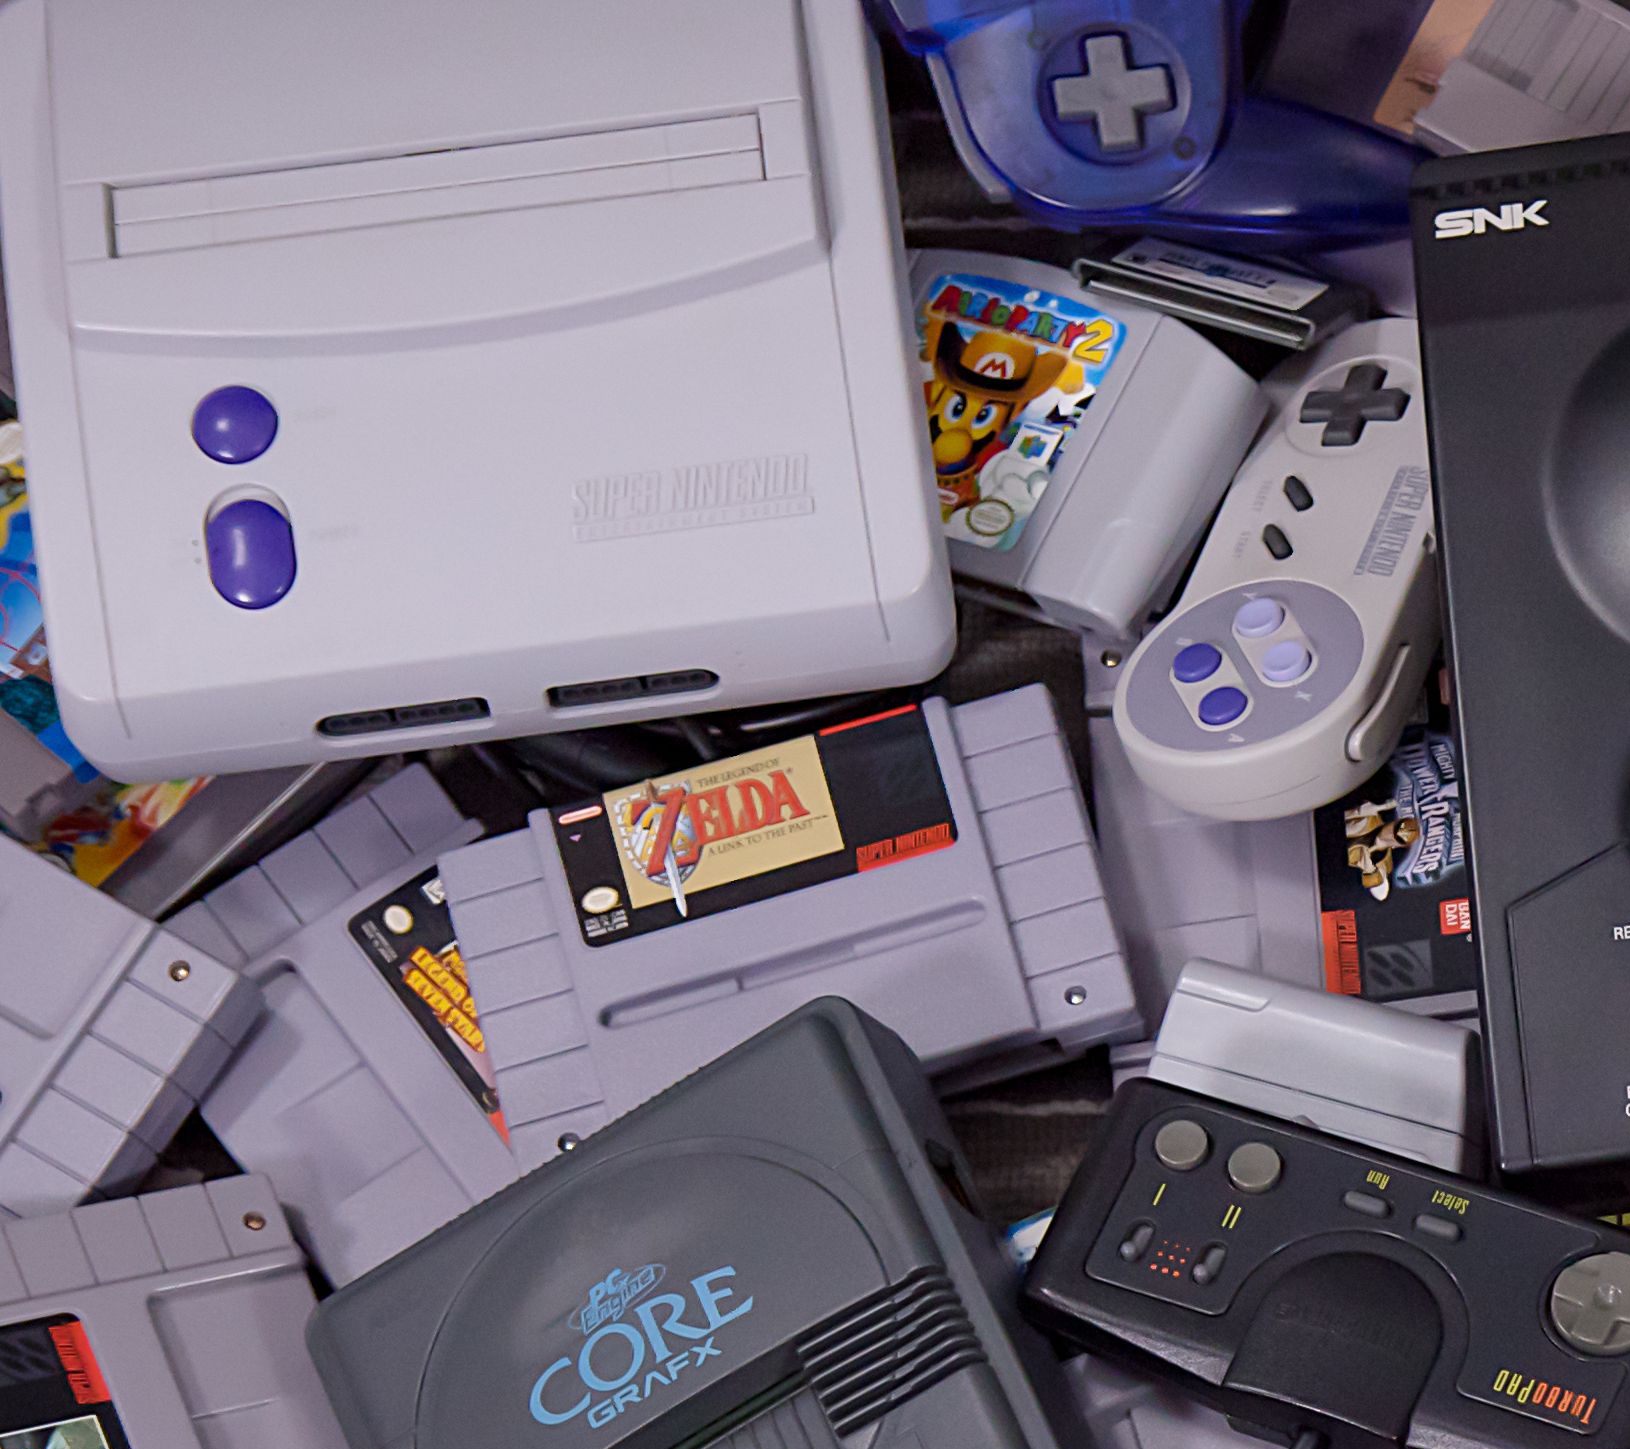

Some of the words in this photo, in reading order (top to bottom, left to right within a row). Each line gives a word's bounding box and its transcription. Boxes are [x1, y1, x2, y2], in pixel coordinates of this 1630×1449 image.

[1434, 201, 1549, 239] SNK
[641, 769, 809, 877] ZELDA
[1431, 1190, 1470, 1214] Select
[529, 1264, 754, 1424] CORE
[588, 1337, 721, 1429] GRAFX
